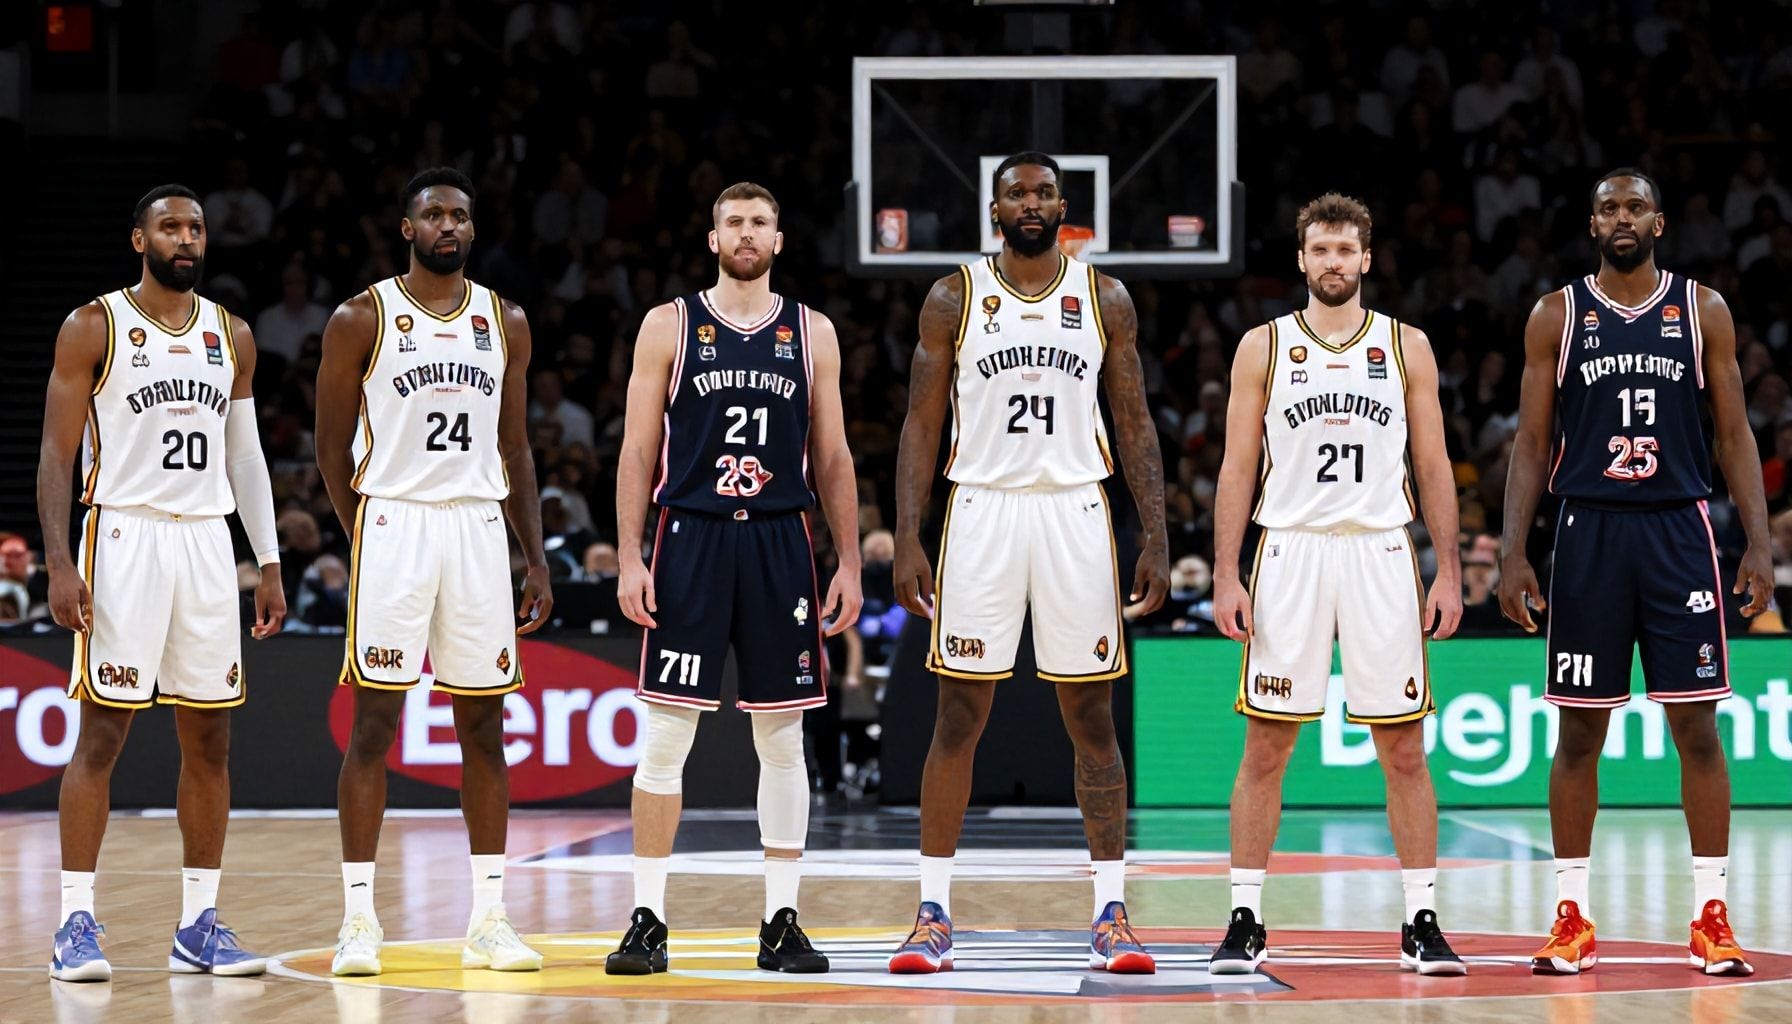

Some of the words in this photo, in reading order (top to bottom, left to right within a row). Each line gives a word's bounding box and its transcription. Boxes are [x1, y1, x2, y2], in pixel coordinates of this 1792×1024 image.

[426, 412, 472, 451] 24
[725, 406, 768, 446] 21
[1007, 394, 1055, 435] 24
[162, 429, 208, 471] 20
[1317, 443, 1364, 483] 27
